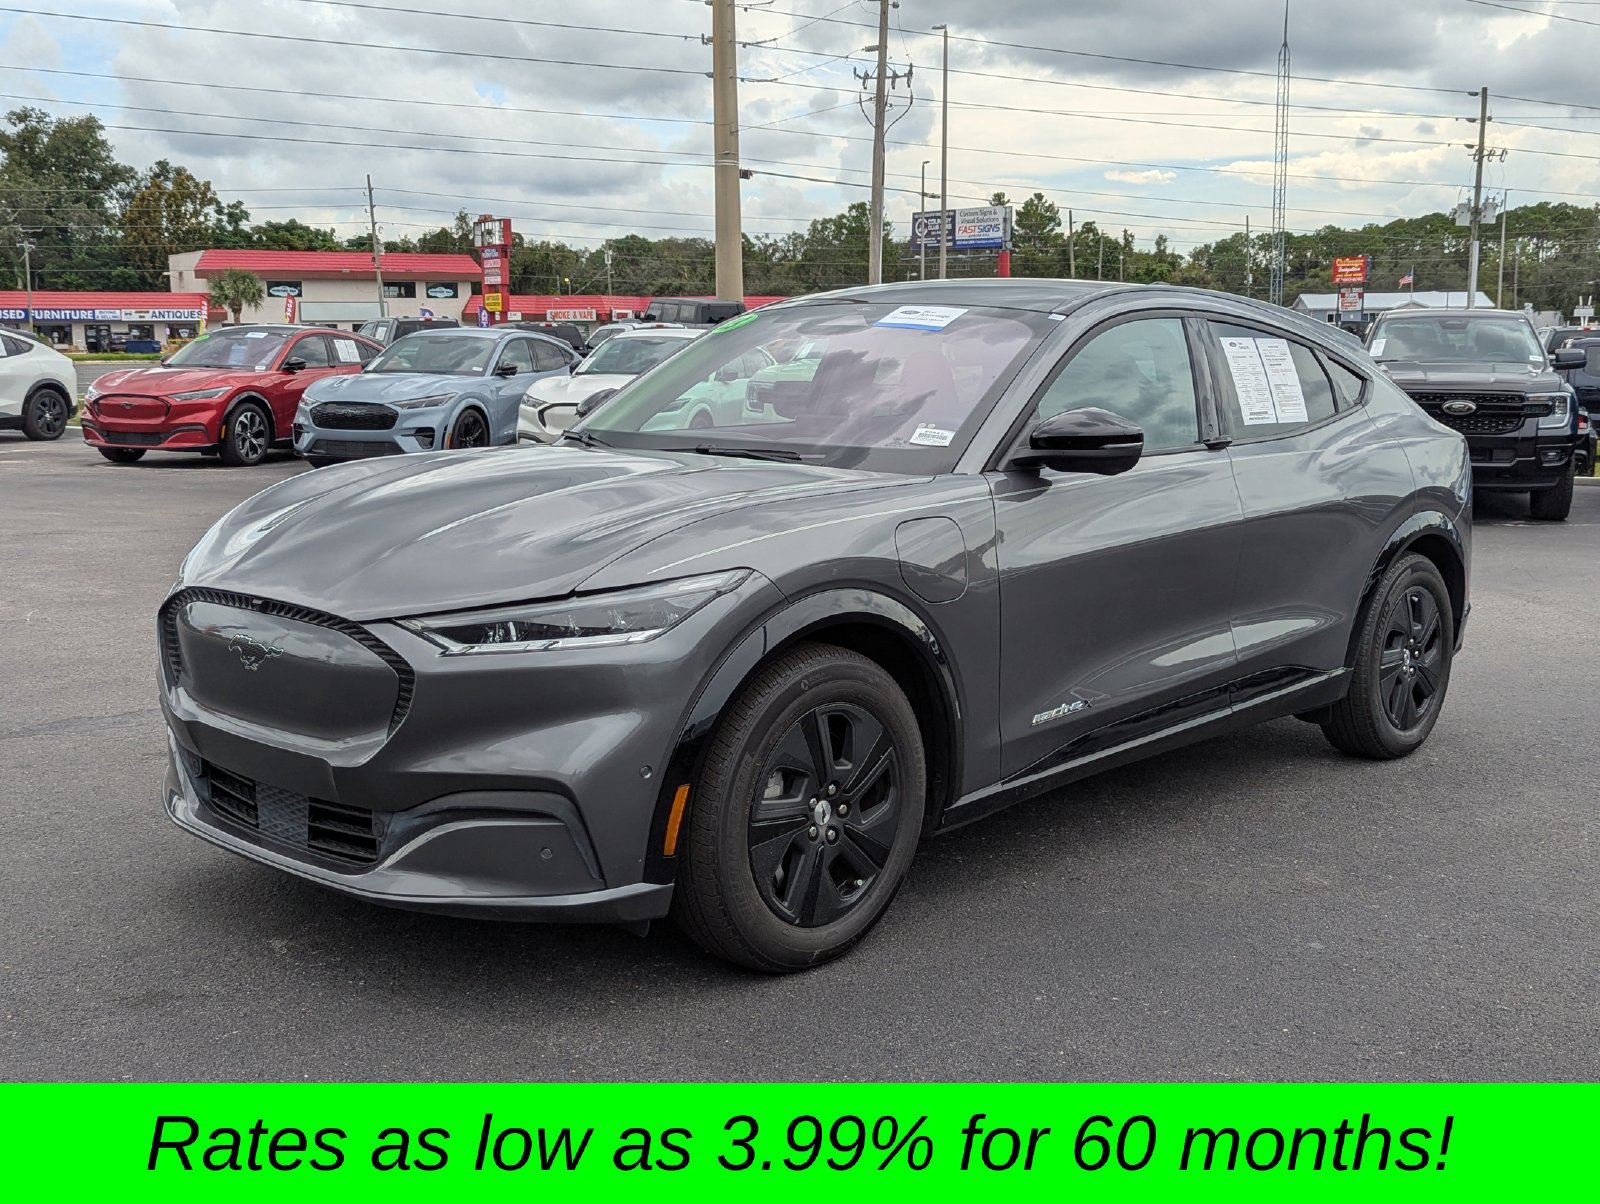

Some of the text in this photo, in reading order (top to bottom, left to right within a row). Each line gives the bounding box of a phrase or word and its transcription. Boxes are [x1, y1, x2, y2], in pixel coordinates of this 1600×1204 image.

[961, 215, 1000, 224] Visual Solutions
[958, 223, 1001, 234] FASTSIGNS
[31, 309, 94, 320] FURNITURE
[150, 309, 202, 320] ANTIQUES
[549, 310, 594, 320] SMOKE & VAPE
